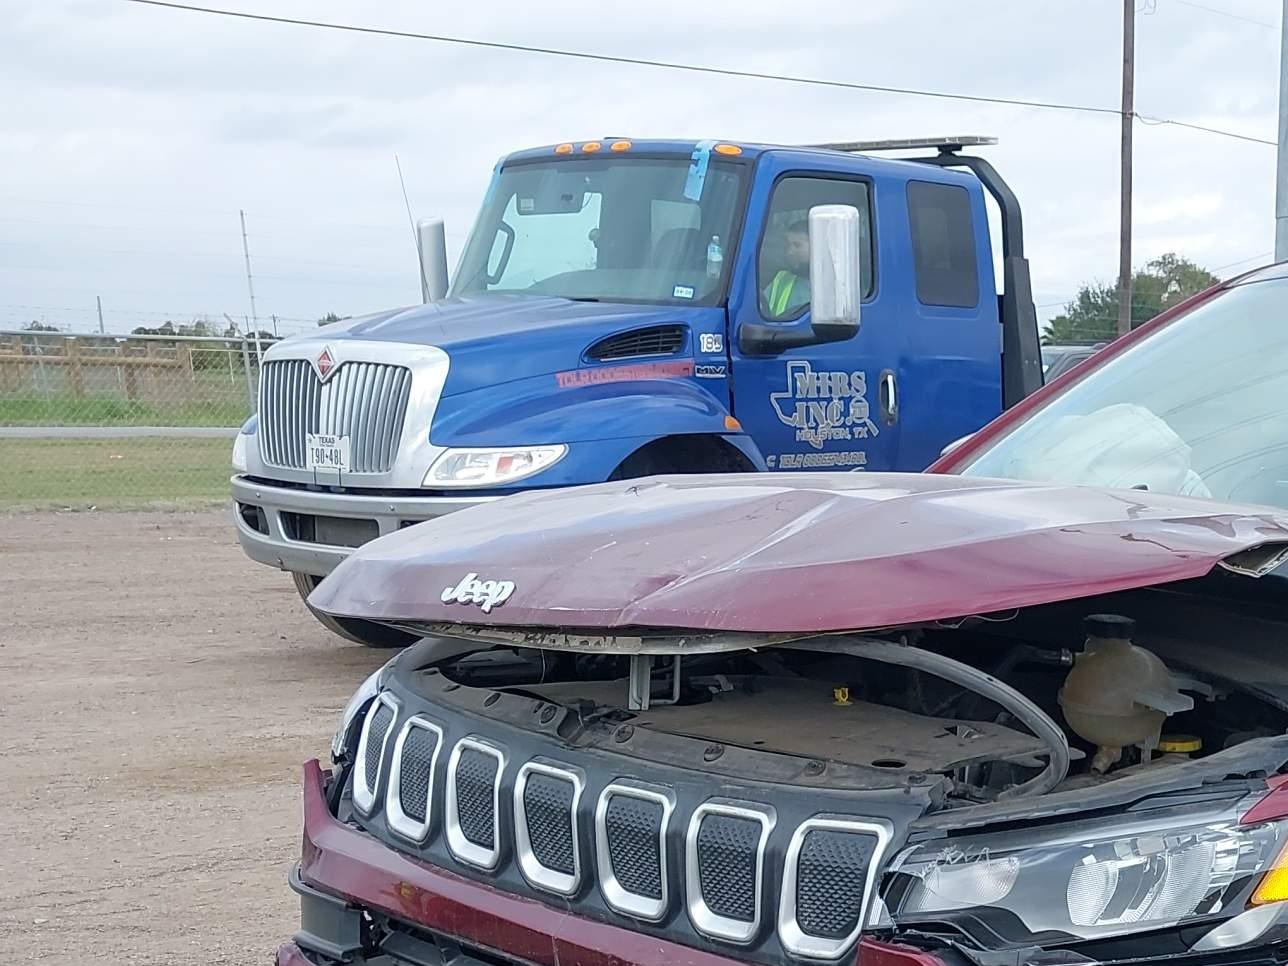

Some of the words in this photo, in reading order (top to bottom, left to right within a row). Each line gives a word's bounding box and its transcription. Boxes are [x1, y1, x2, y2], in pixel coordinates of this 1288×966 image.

[853, 426, 869, 439] TX
[319, 436, 336, 444] TEXAS
[440, 572, 516, 614] Jeep
